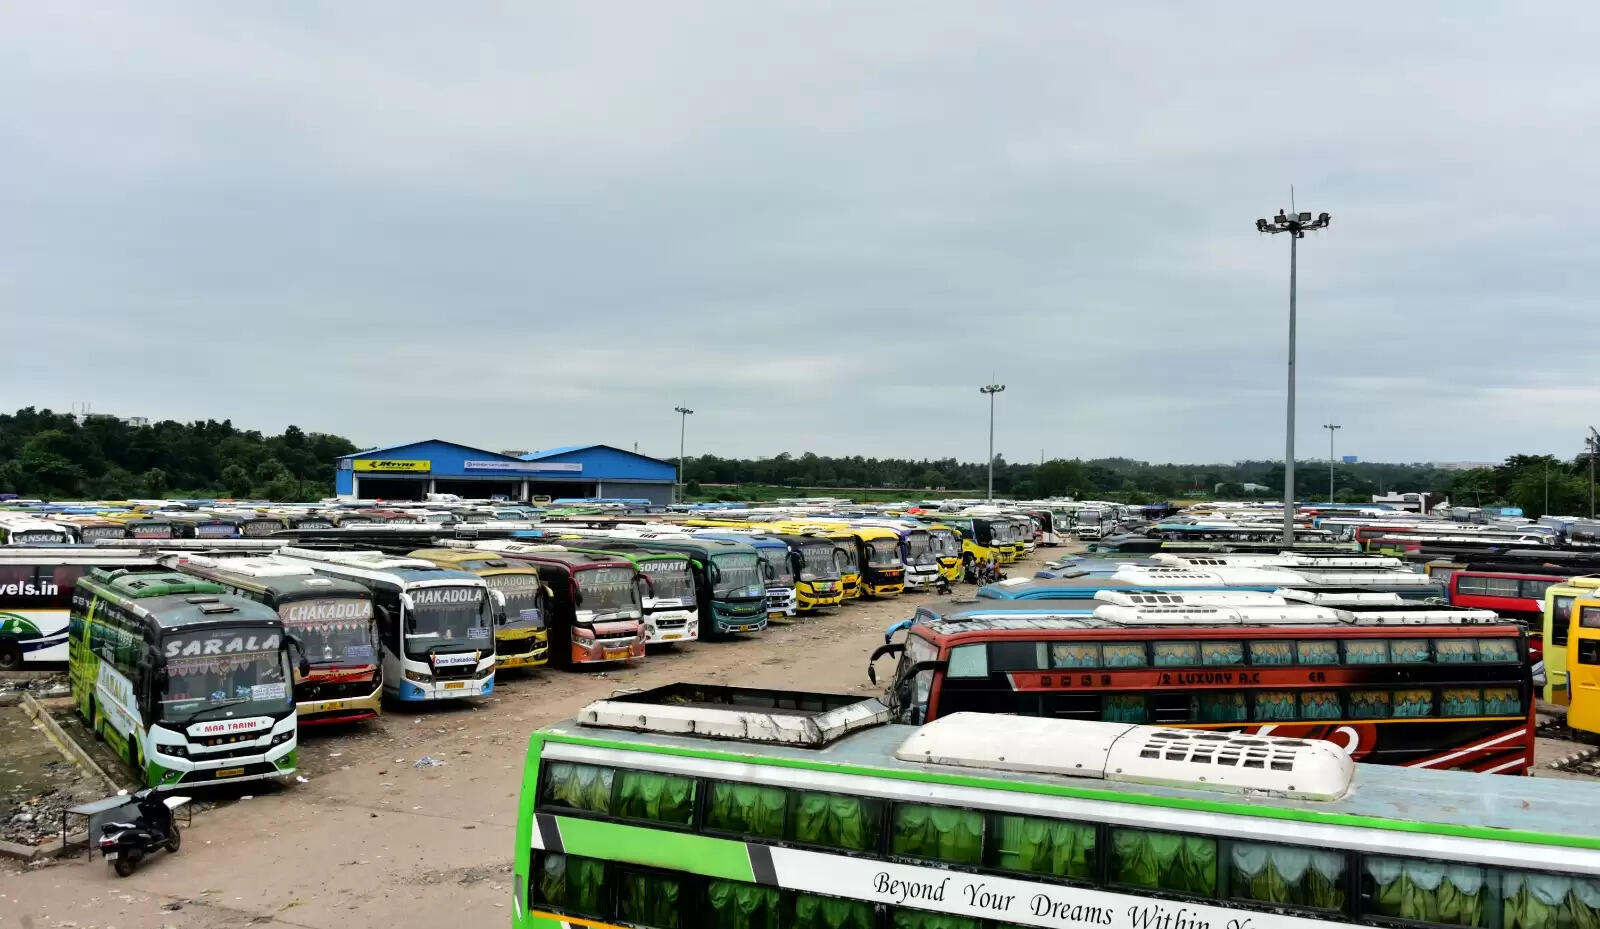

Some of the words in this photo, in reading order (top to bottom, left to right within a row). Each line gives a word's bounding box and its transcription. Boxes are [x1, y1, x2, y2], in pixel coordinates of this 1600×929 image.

[14, 534, 63, 543] SANSKAR
[83, 528, 125, 538] SANSKAR
[289, 602, 371, 620] CHAKADOLA
[165, 635, 280, 657] SARALA
[1178, 673, 1232, 684] LUXURY
[874, 872, 950, 903] Beyond
[963, 883, 1015, 911] Your
[1030, 893, 1114, 925] Dreams
